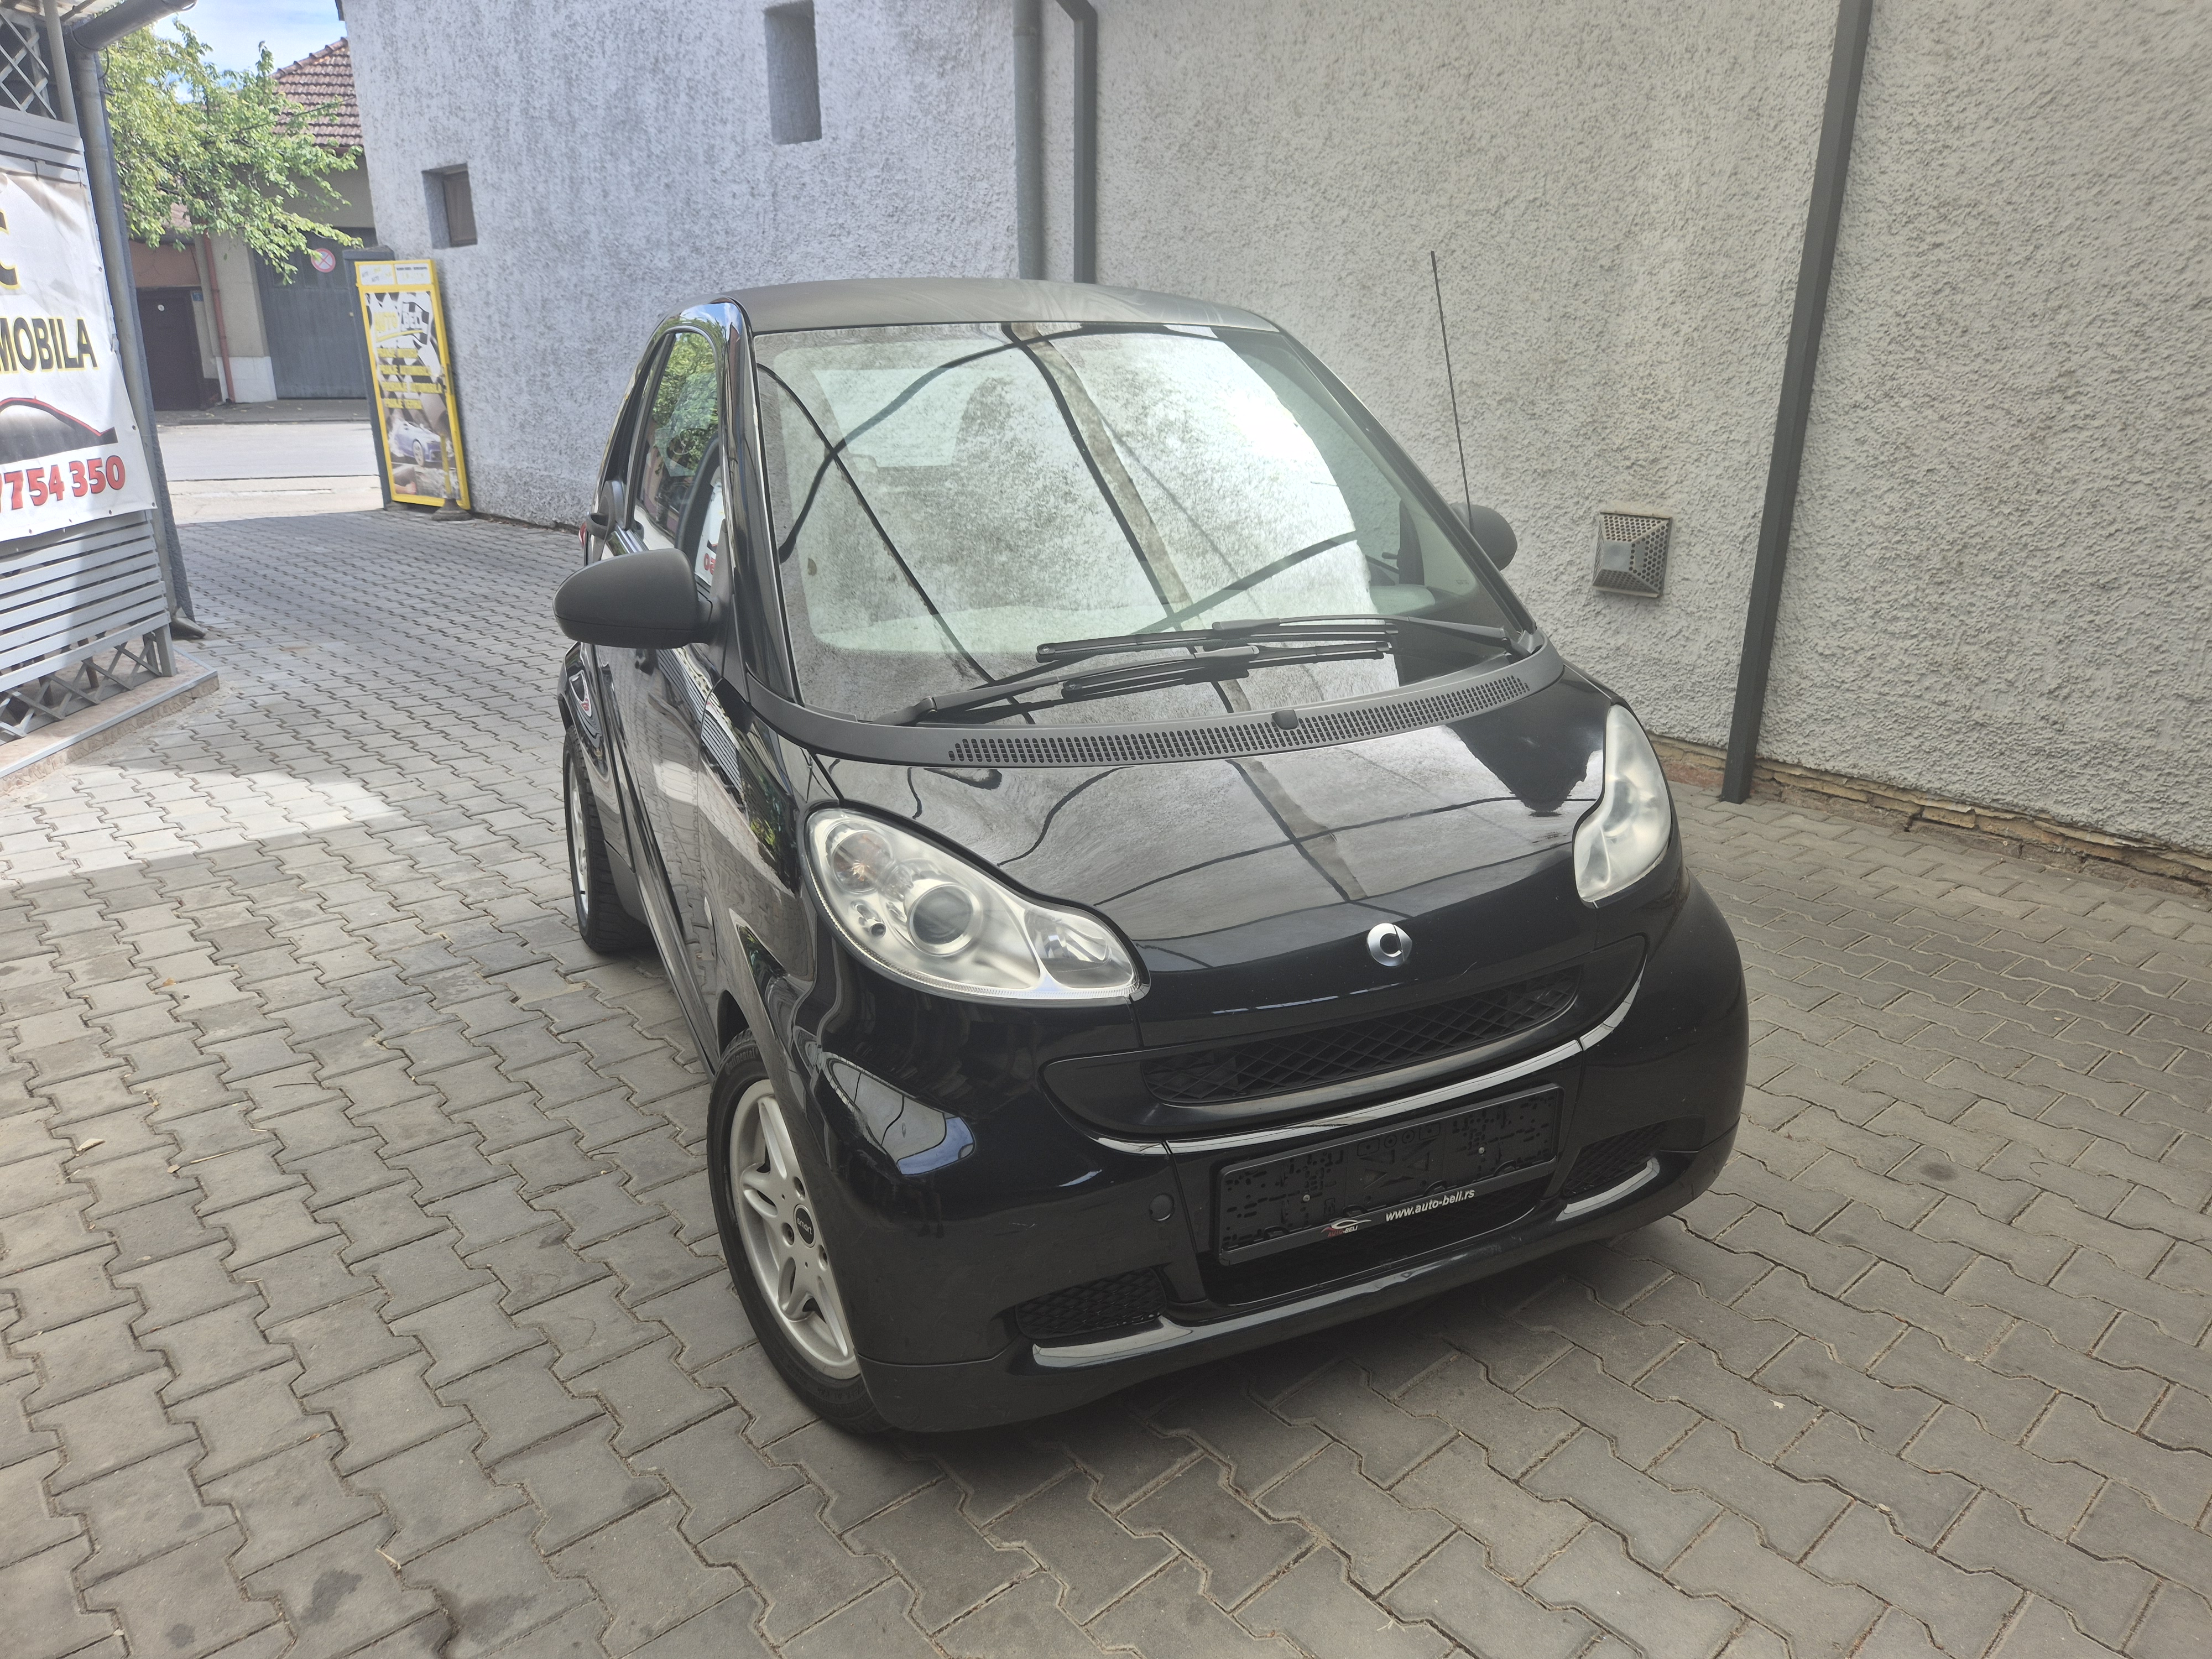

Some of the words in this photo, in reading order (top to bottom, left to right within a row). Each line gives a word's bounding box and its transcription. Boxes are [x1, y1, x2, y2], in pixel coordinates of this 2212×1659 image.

[0, 464, 65, 513] 754
[69, 455, 126, 497] 350
[797, 1218, 812, 1235] smart
